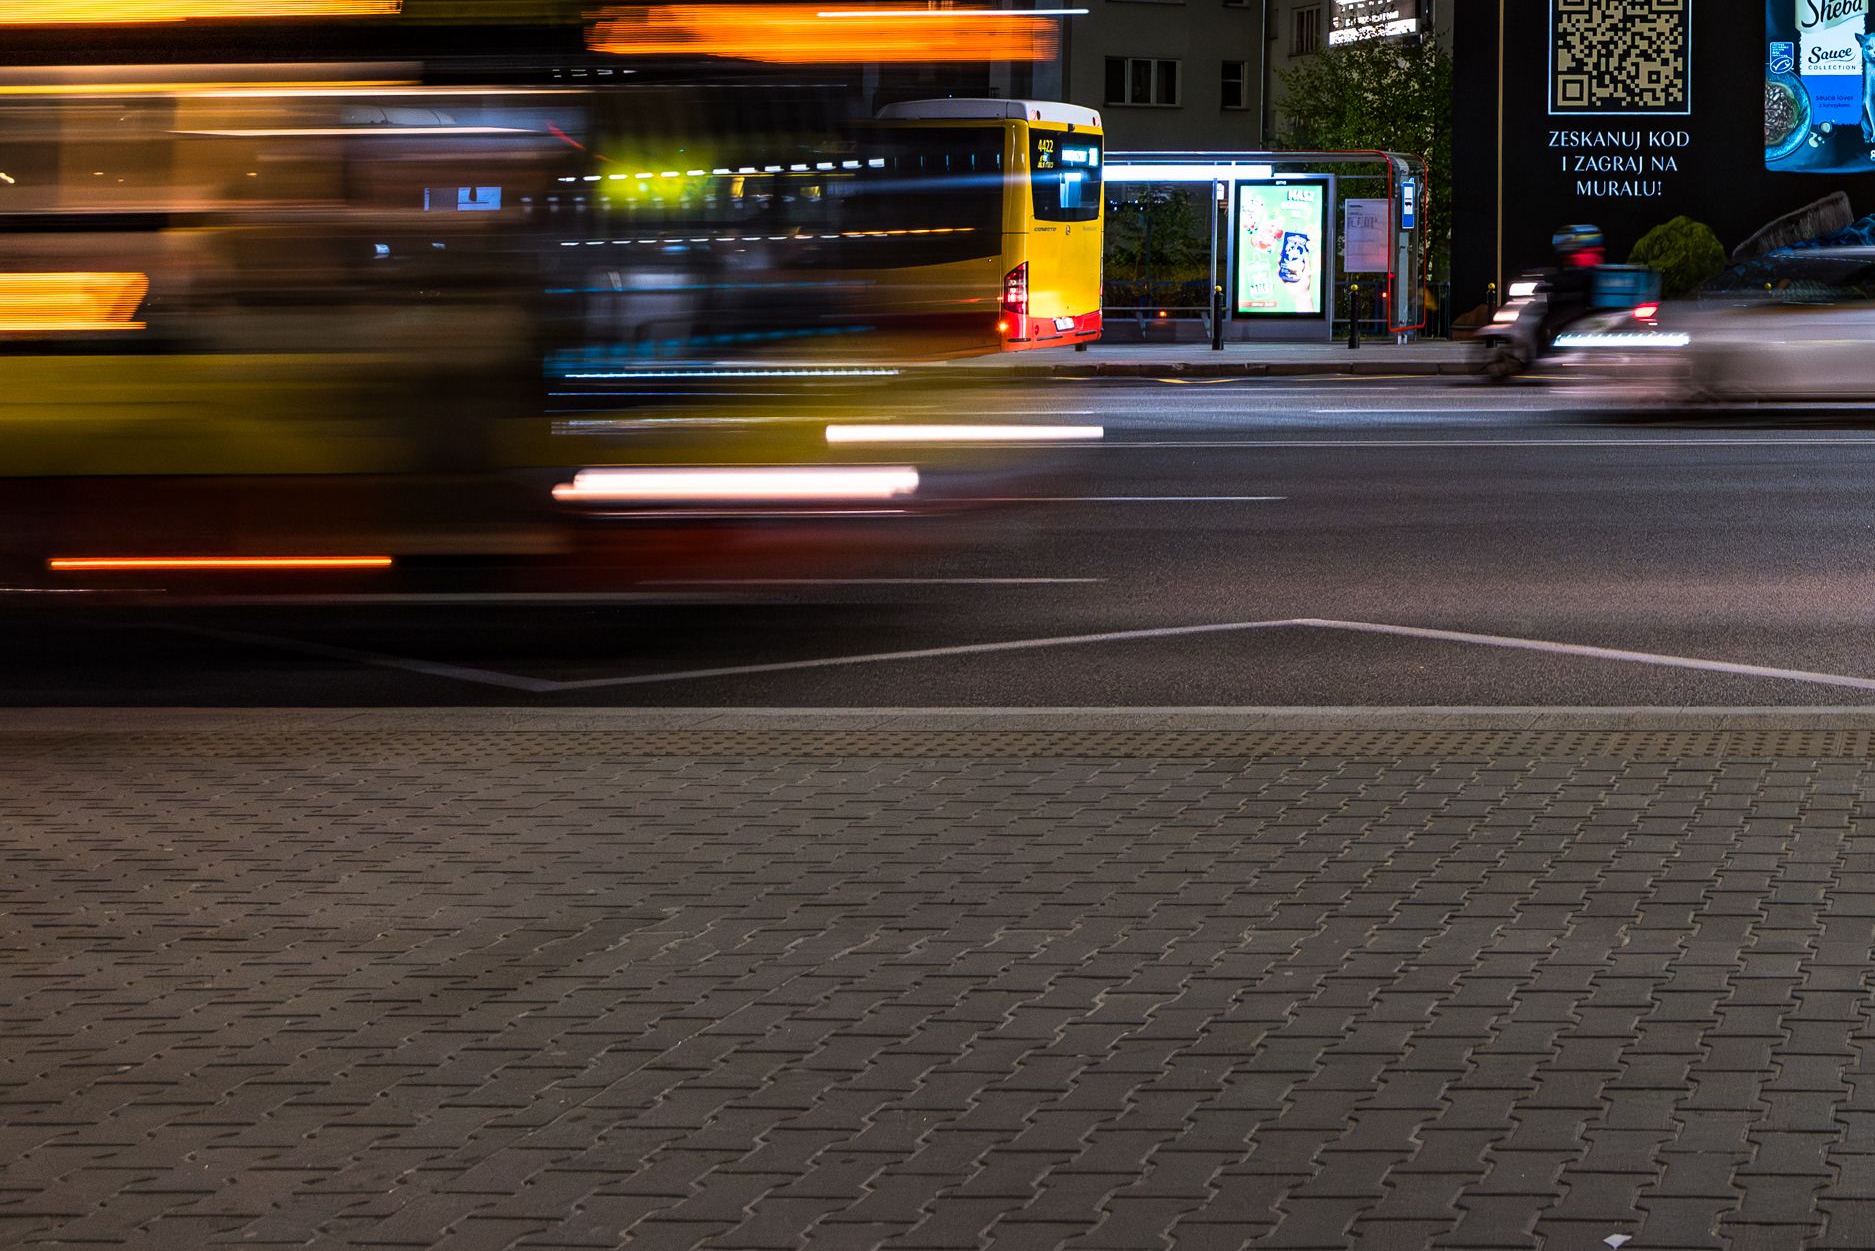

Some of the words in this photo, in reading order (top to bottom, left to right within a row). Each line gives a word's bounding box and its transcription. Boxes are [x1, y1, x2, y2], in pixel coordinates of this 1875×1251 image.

[1808, 46, 1855, 64] Sauce
[1548, 130, 1641, 150] ZESKANUJ
[1649, 130, 1690, 148] KOD
[1562, 155, 1567, 172] I
[1574, 155, 1643, 176] ZAGRAJ
[1651, 155, 1678, 172] NA
[1576, 180, 1662, 197] MURALU!
